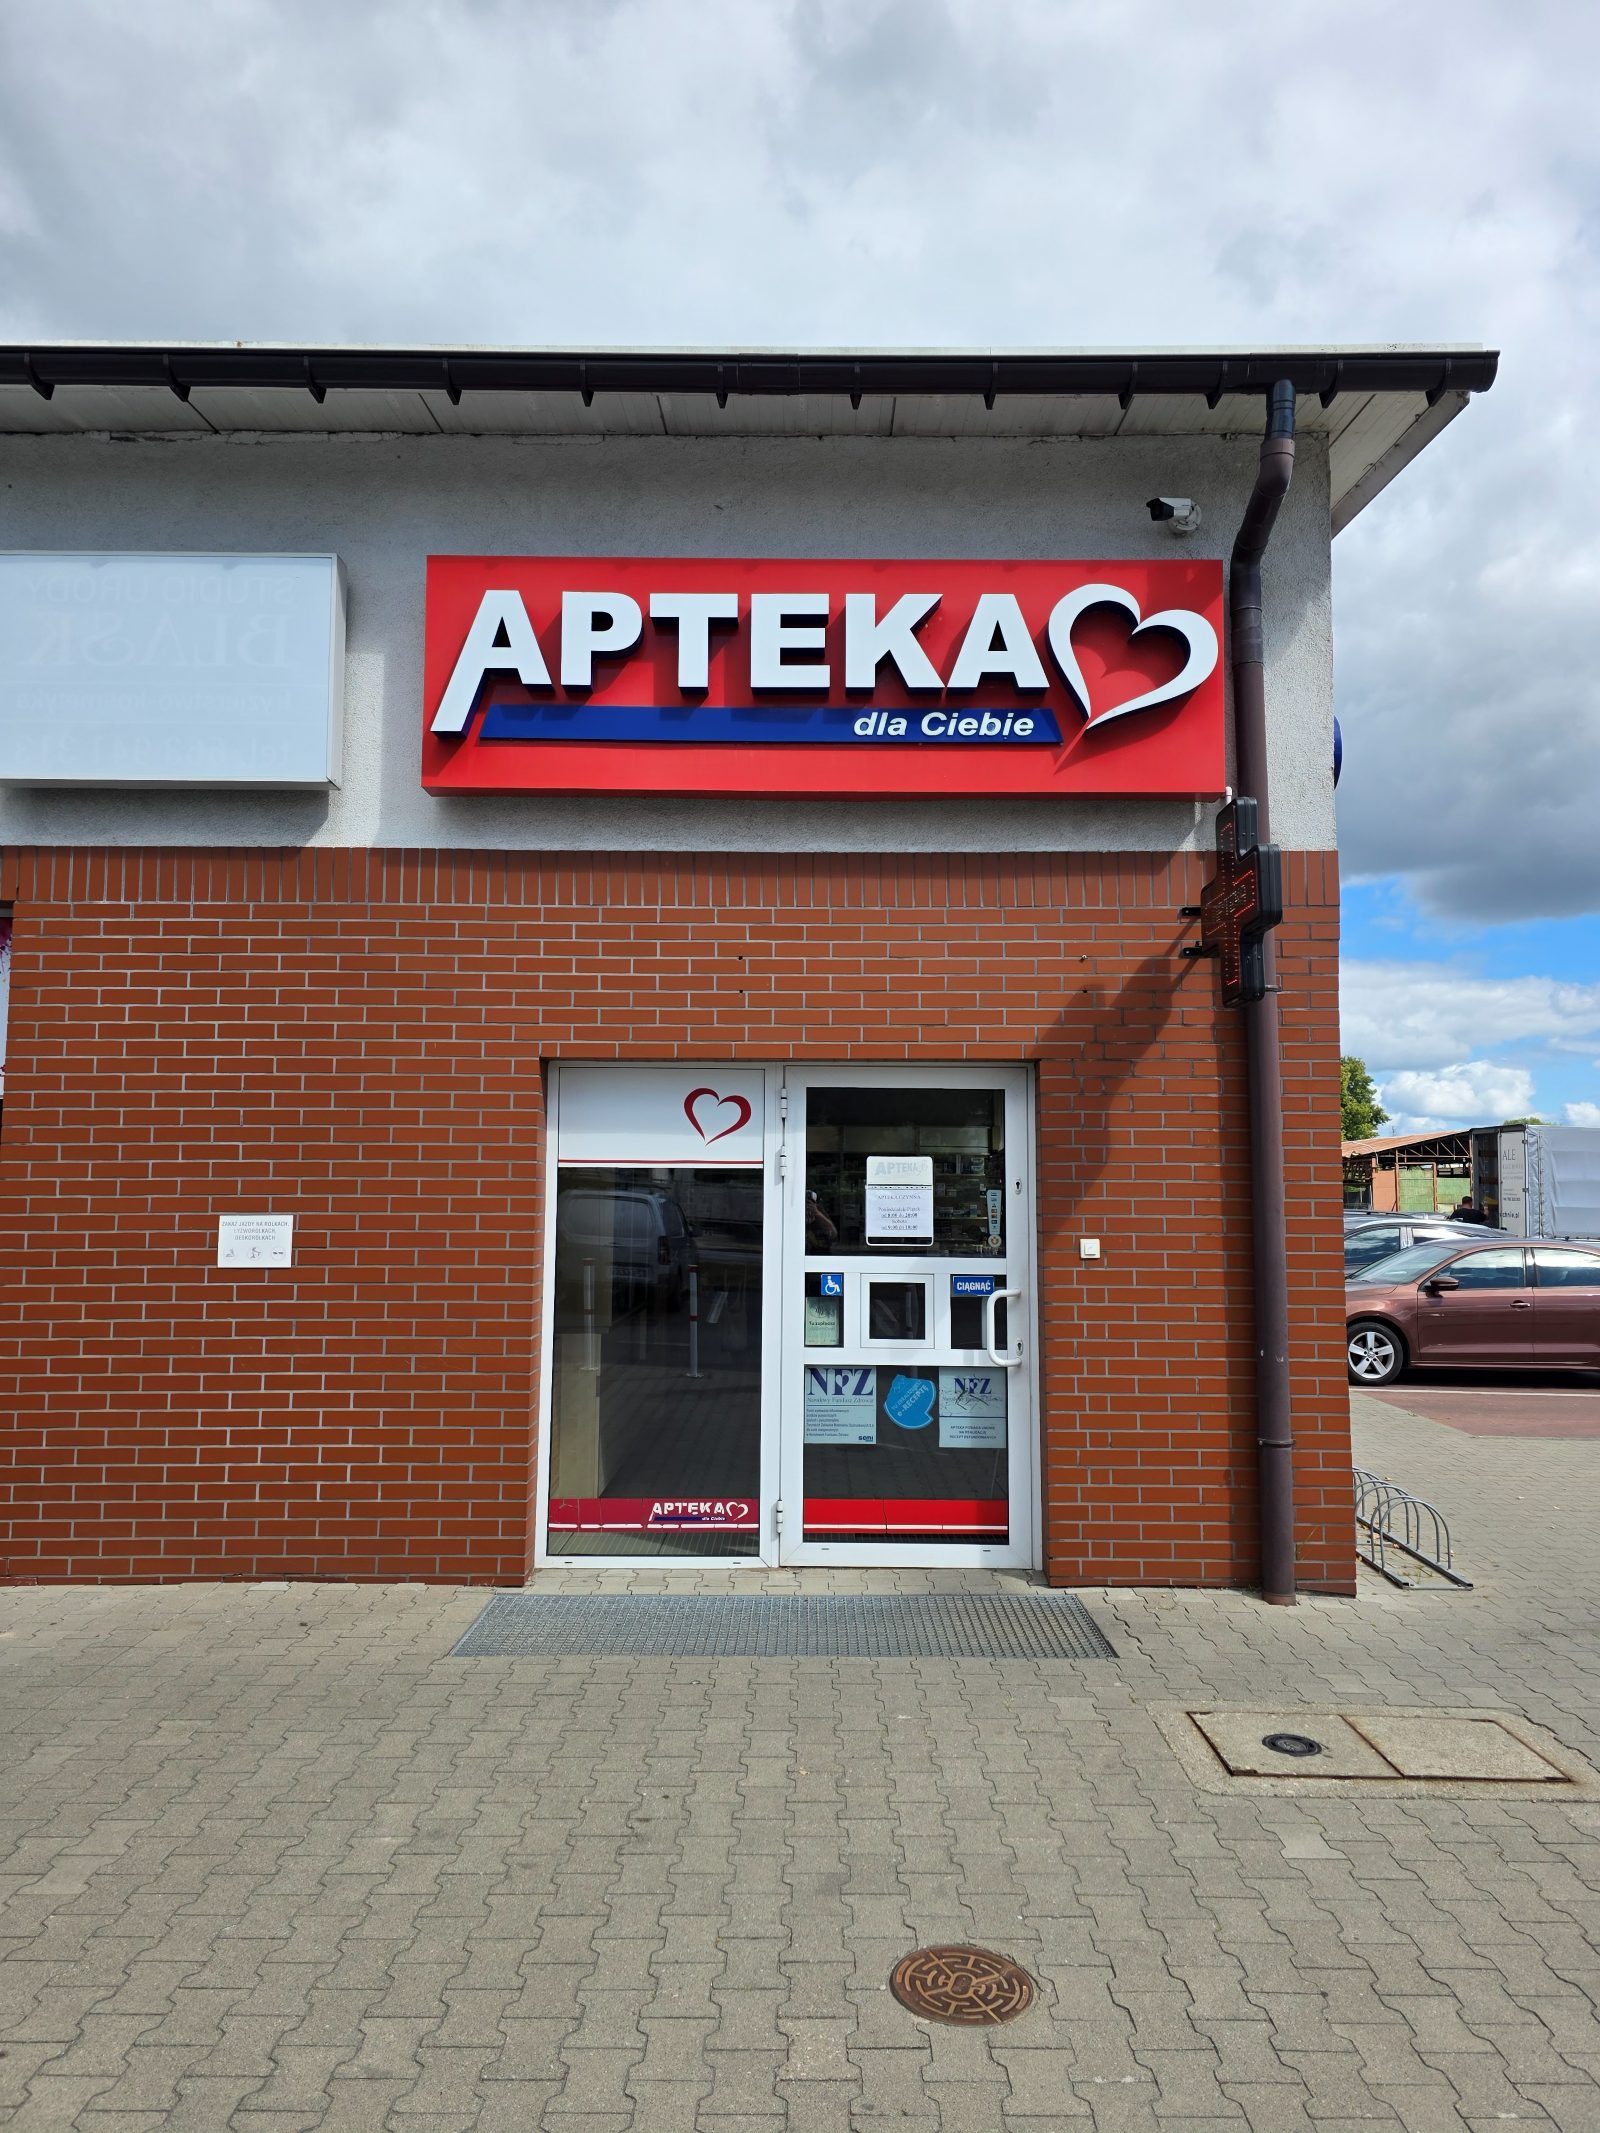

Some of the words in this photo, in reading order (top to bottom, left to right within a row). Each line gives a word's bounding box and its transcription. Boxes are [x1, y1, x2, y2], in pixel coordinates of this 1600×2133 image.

[430, 589, 1050, 734] APTEKA
[853, 710, 908, 737] dla
[920, 711, 1034, 737] Ciebie
[1503, 1149, 1516, 1160] ALE
[956, 1279, 991, 1292] CIĄGNĄĆ
[807, 1367, 874, 1396] NFZ
[954, 1377, 992, 1394] NFZ
[648, 1502, 725, 1522] APTEKA
